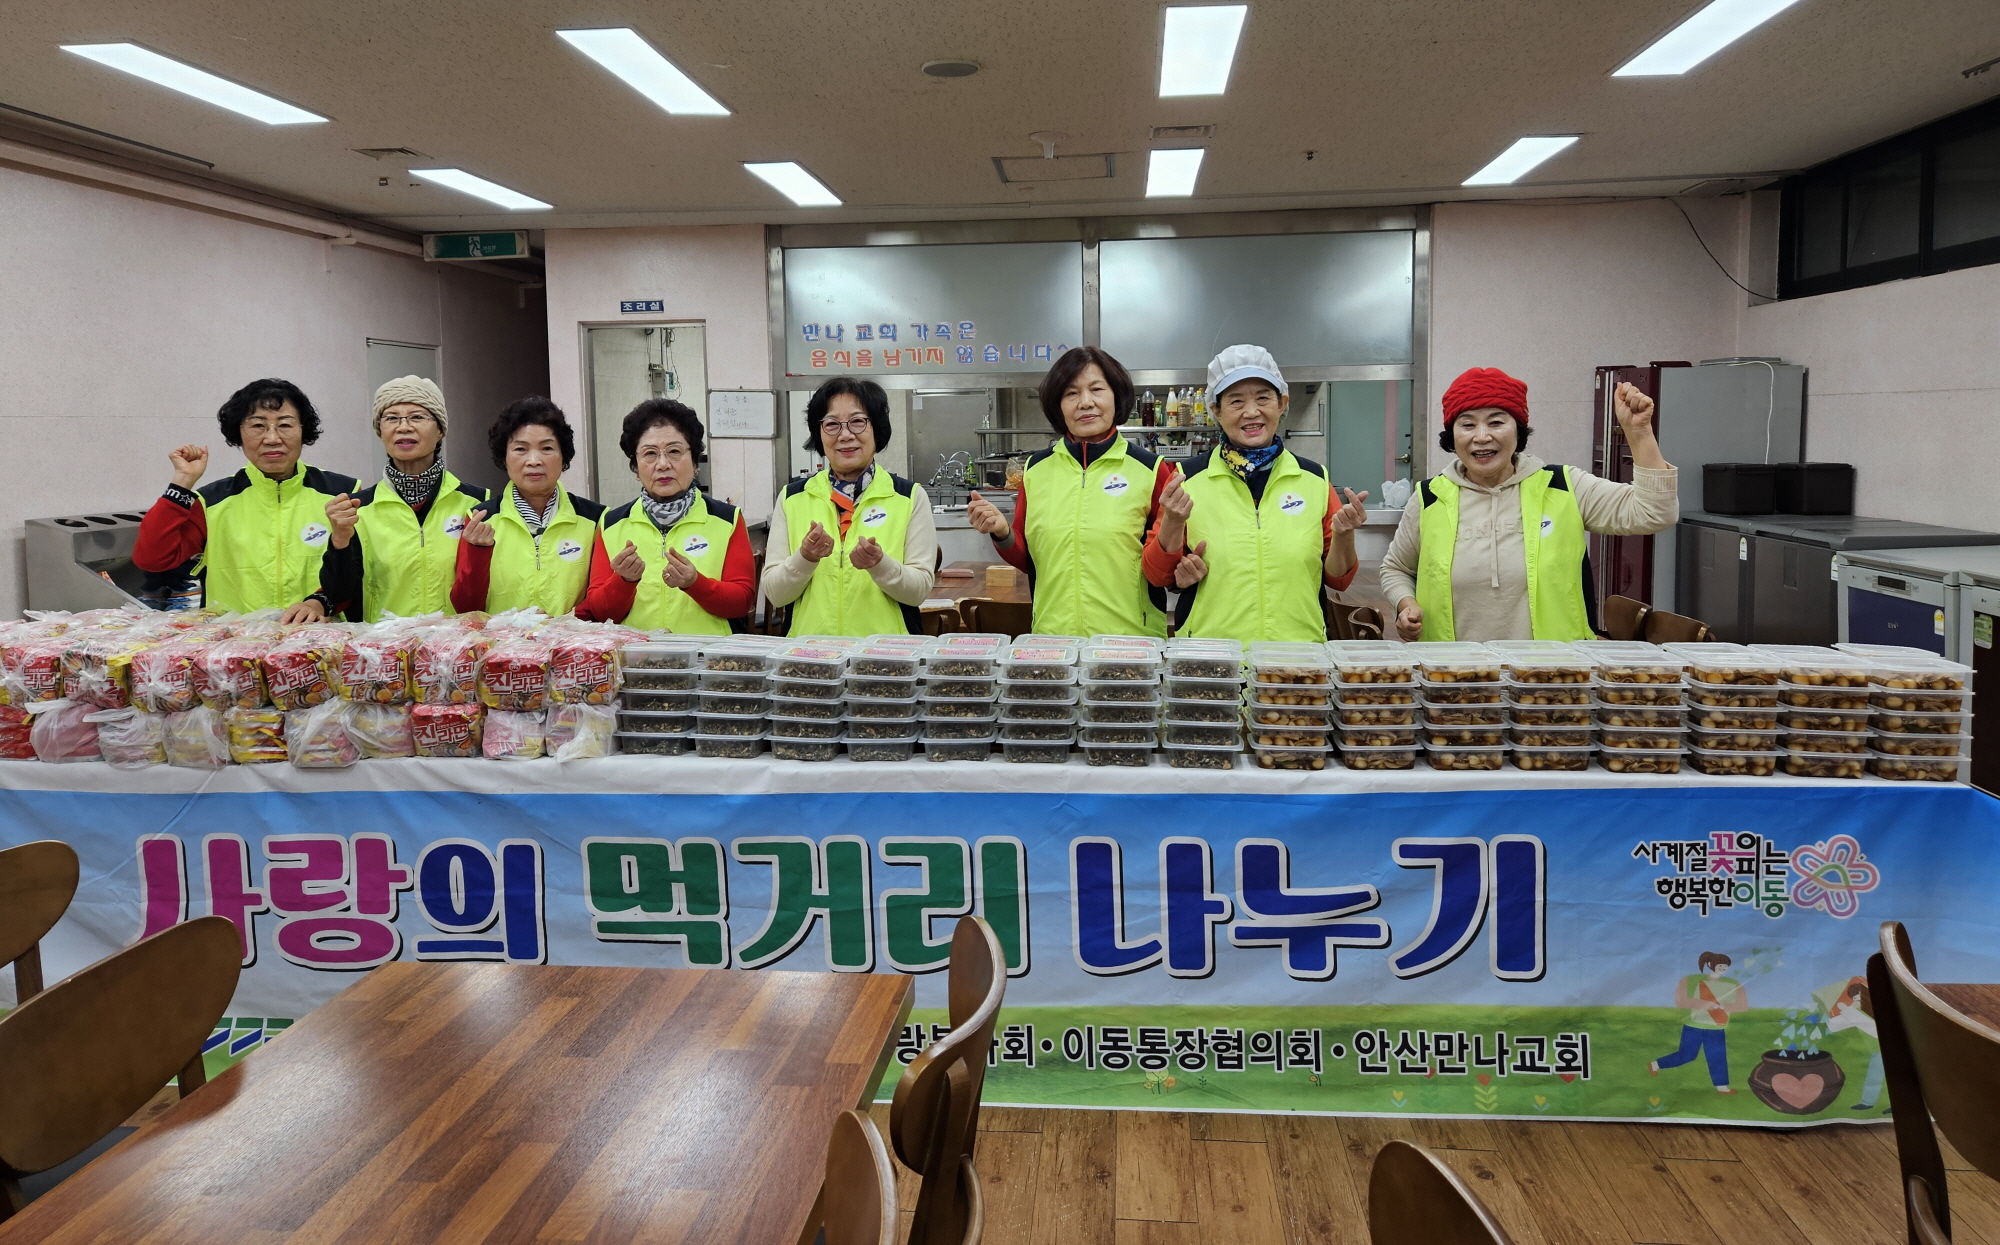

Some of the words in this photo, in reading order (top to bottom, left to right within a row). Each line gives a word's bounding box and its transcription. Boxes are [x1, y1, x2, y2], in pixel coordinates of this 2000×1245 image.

[622, 301, 660, 311] 조리실
[801, 323, 845, 343] 만나
[910, 320, 977, 342] 가족은
[810, 348, 874, 369] 음식을
[882, 346, 946, 368] 남기지
[266, 664, 320, 698] 진라면
[485, 671, 545, 695] 진라면
[554, 662, 609, 690] 진라면
[412, 723, 470, 748] 진라면
[125, 833, 547, 970] 사랑의
[581, 836, 1030, 977] 먹거리
[1069, 834, 1546, 981] 나누기
